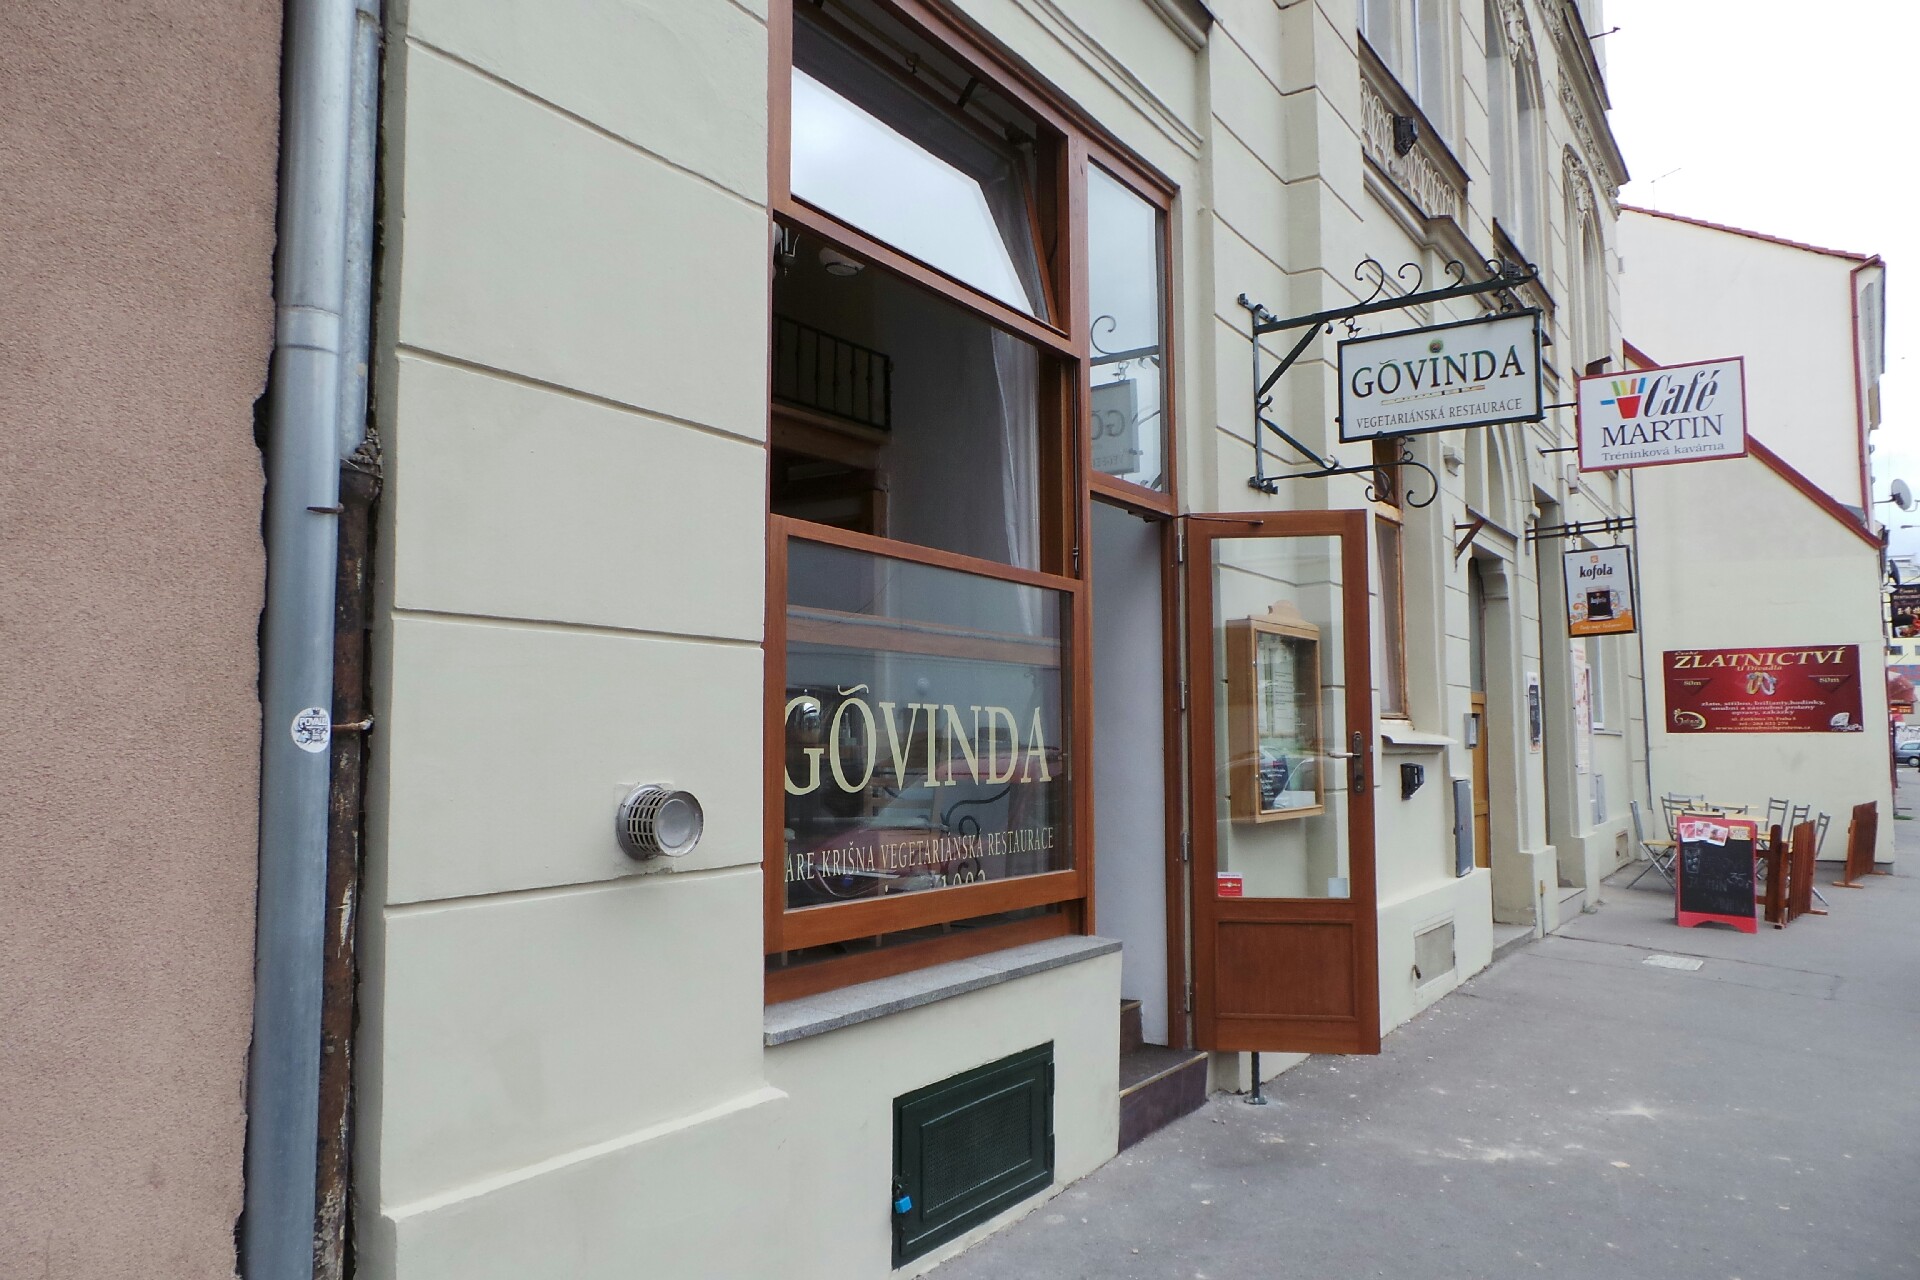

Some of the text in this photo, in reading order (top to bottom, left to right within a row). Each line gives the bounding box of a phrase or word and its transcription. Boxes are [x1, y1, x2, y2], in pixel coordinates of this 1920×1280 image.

[1643, 369, 1721, 418] Café
[1356, 397, 1522, 429] VEGETARIÁNSKÁ RESTAURACE
[1601, 413, 1724, 448] MARTIN
[1601, 441, 1725, 462] Tréninková kavárna
[1579, 563, 1613, 580] kofola
[1673, 646, 1846, 669] ZLATNICTVÍ
[822, 841, 876, 878] KRIŠNA
[881, 828, 983, 869] VEGETARIÁNSKÁ
[988, 826, 1054, 856] RESTAURACE
